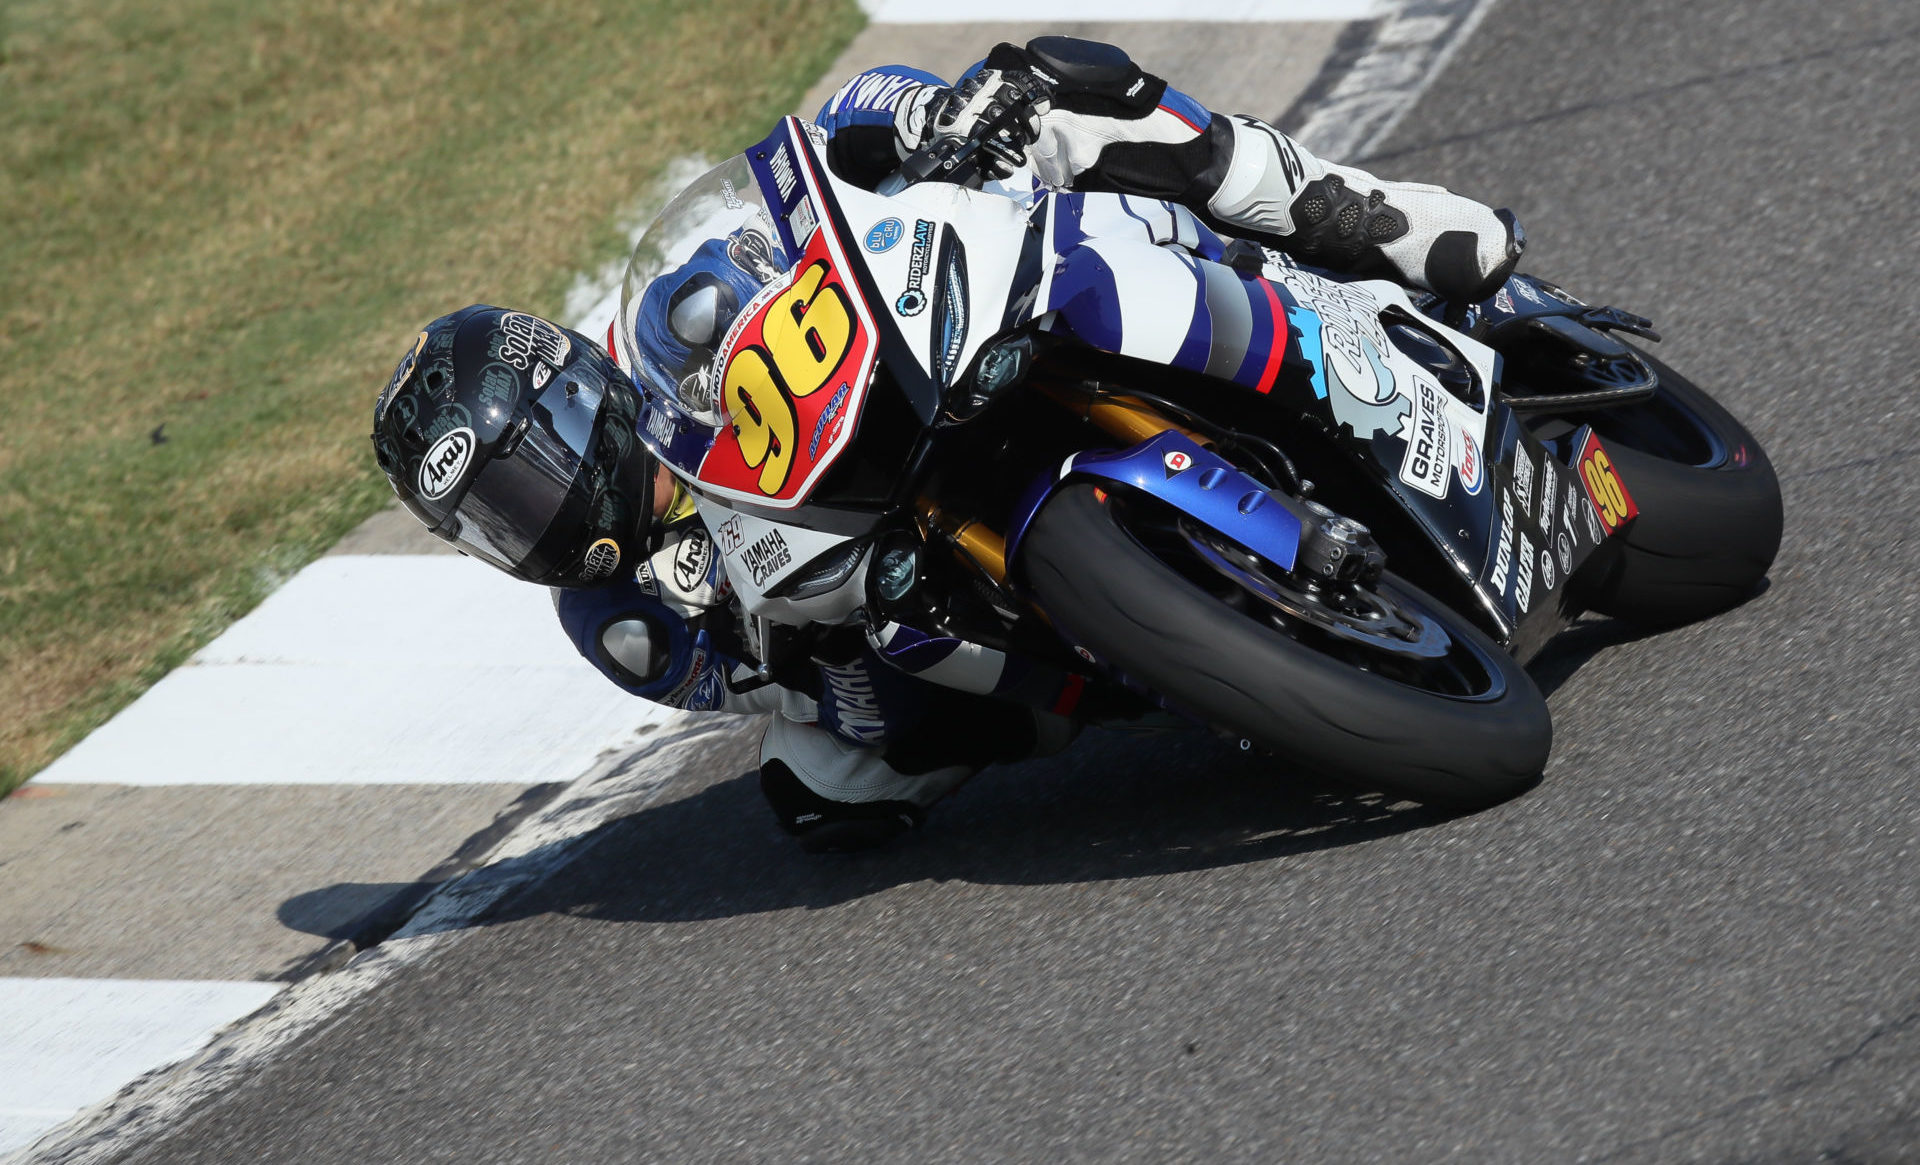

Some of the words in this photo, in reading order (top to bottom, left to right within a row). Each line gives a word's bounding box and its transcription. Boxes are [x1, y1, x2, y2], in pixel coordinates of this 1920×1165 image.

[770, 141, 797, 203] YAMAHA
[499, 315, 534, 370] Solar
[479, 370, 498, 406] Solar
[495, 371, 513, 402] MAX
[721, 258, 858, 496] 96
[646, 406, 676, 448] YAMAHA
[1411, 383, 1435, 480] GRAVES
[426, 434, 463, 496] Arai
[1584, 447, 1628, 527] 96
[579, 546, 604, 583] Solar
[677, 532, 706, 590] Arai
[741, 528, 787, 572] YAMAHA
[752, 548, 792, 589] GRAVES
[1490, 487, 1516, 596] DUNLOP
[1515, 532, 1534, 613] GALFER
